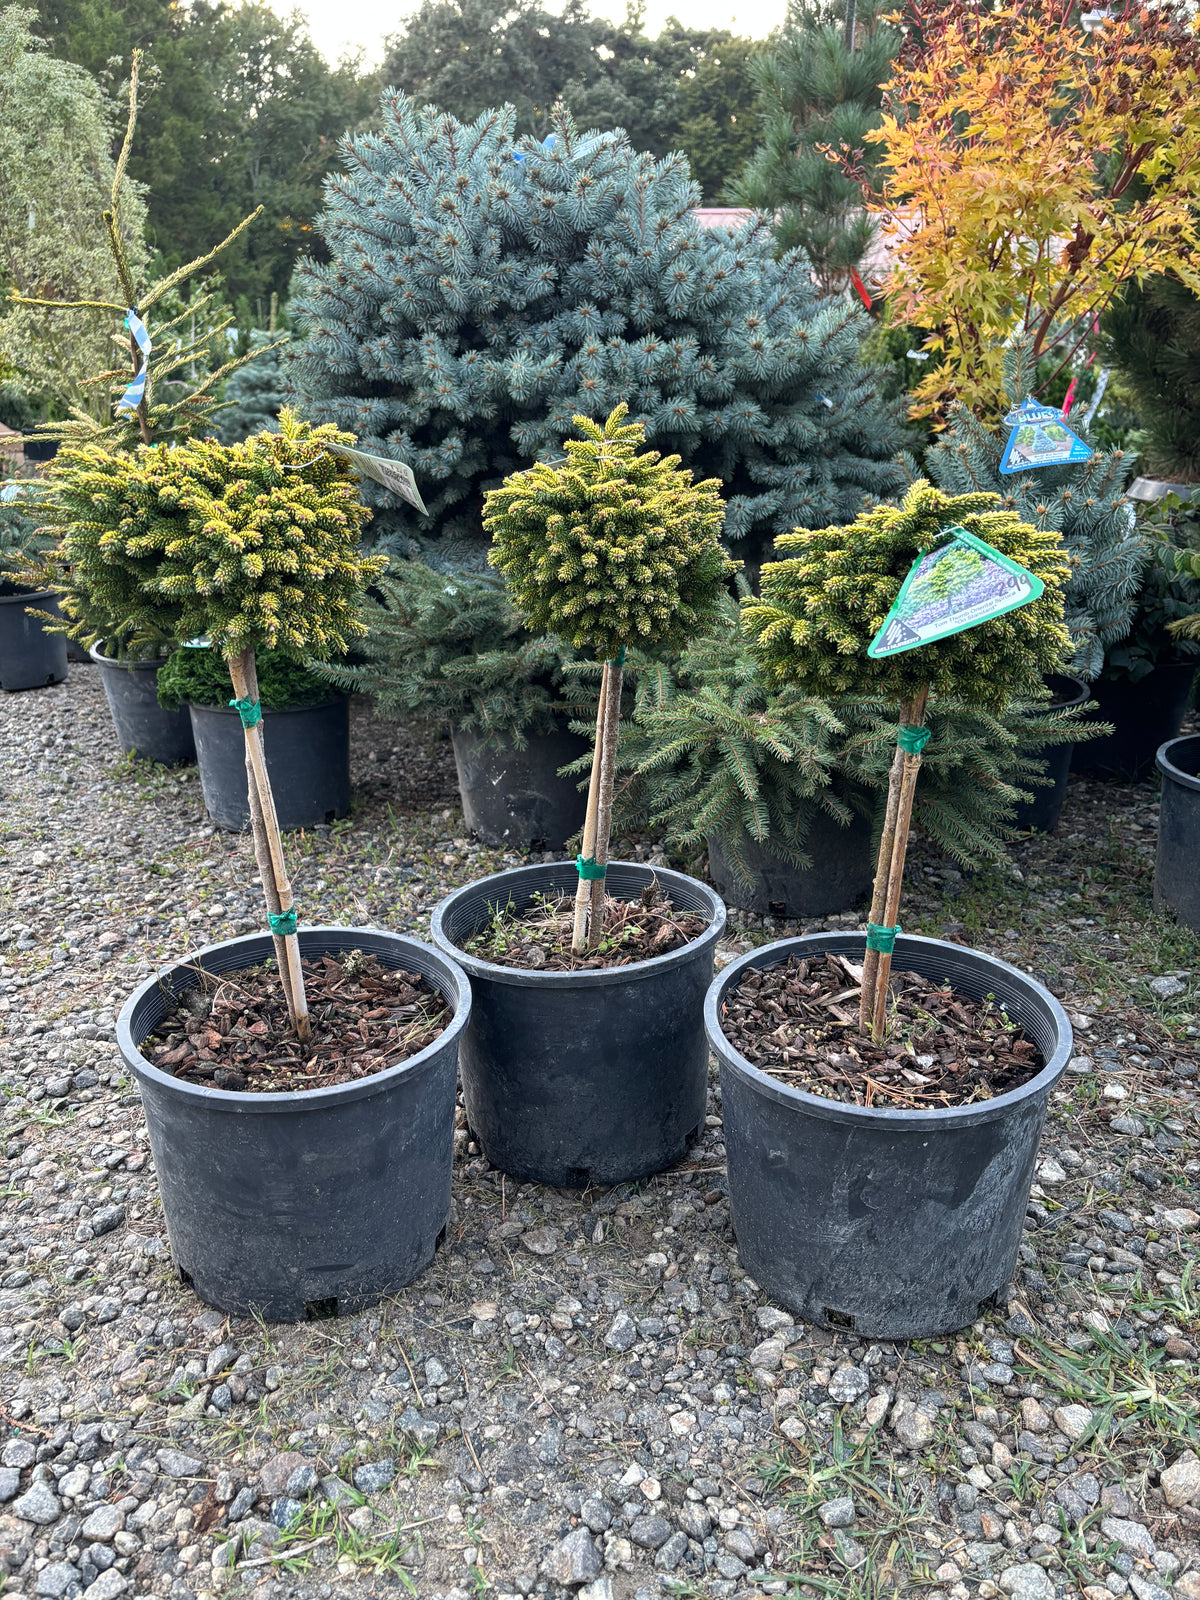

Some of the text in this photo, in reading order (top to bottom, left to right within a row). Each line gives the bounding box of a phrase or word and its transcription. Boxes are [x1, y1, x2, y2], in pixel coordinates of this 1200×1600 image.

[1018, 411, 1054, 422] BLUES
[997, 573, 1034, 597] 299
[935, 620, 948, 628] Tom
[950, 610, 970, 621] Thumb
[971, 601, 994, 614] Oriental
